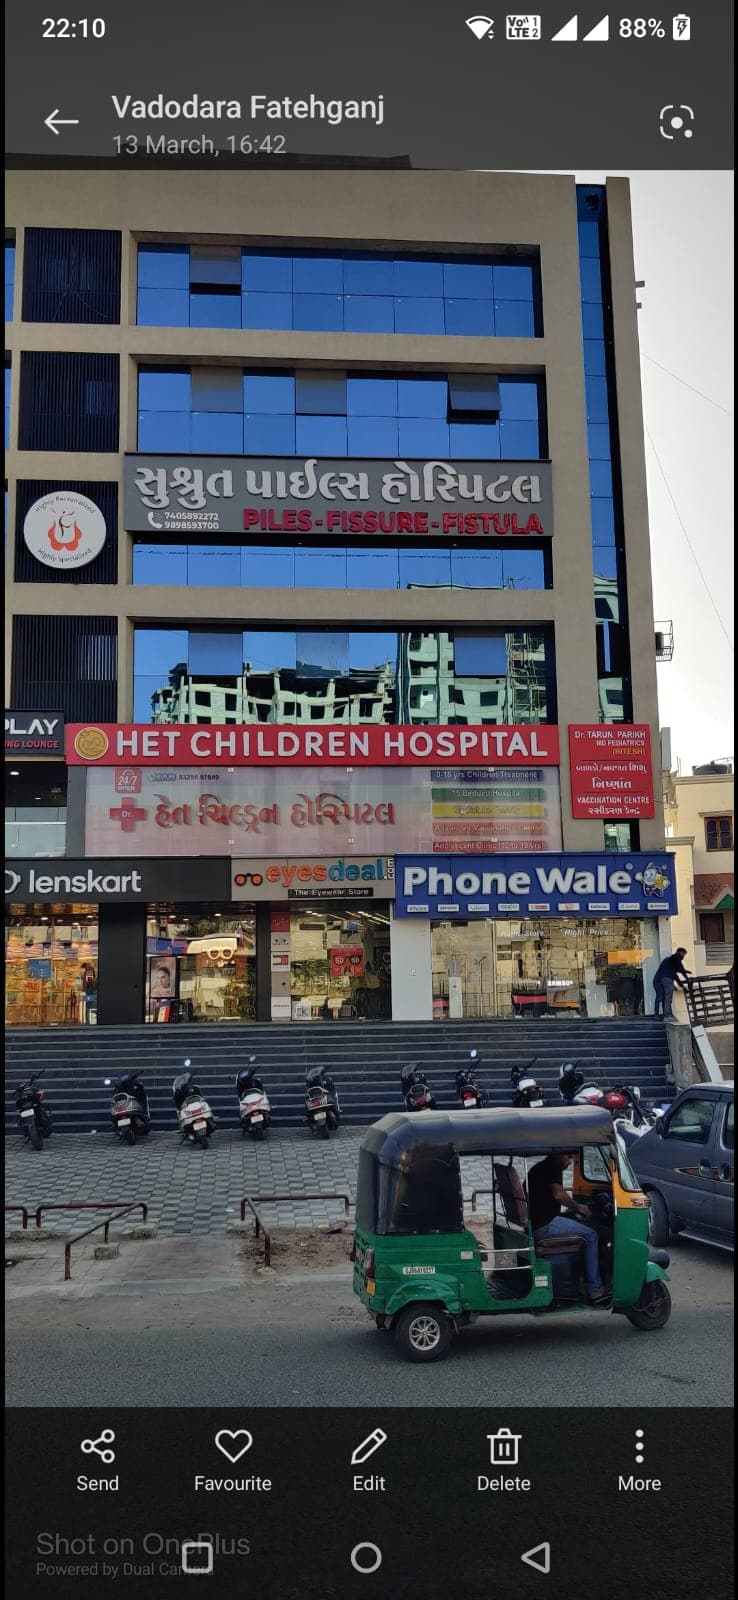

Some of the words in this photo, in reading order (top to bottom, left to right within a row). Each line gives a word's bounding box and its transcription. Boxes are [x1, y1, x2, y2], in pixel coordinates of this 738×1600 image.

[134, 466, 234, 509] સુશ્રુત
[381, 461, 542, 503] હોસ્પિટલ
[164, 521, 219, 530] 9898593700
[575, 731, 586, 739] Dr.
[617, 730, 646, 738] PARIKH
[116, 731, 180, 757] HET
[191, 731, 369, 757] CHILDREN
[384, 731, 548, 757] HOSPITAL
[118, 775, 137, 786] 24/7
[576, 796, 621, 804] VACCINATION
[624, 796, 650, 804] CENTRE
[153, 794, 191, 828] હેત
[291, 793, 397, 828] હોસ્પિટલ
[29, 869, 142, 894] lenskart
[312, 889, 345, 897] Eyewear
[588, 928, 609, 936] Price
